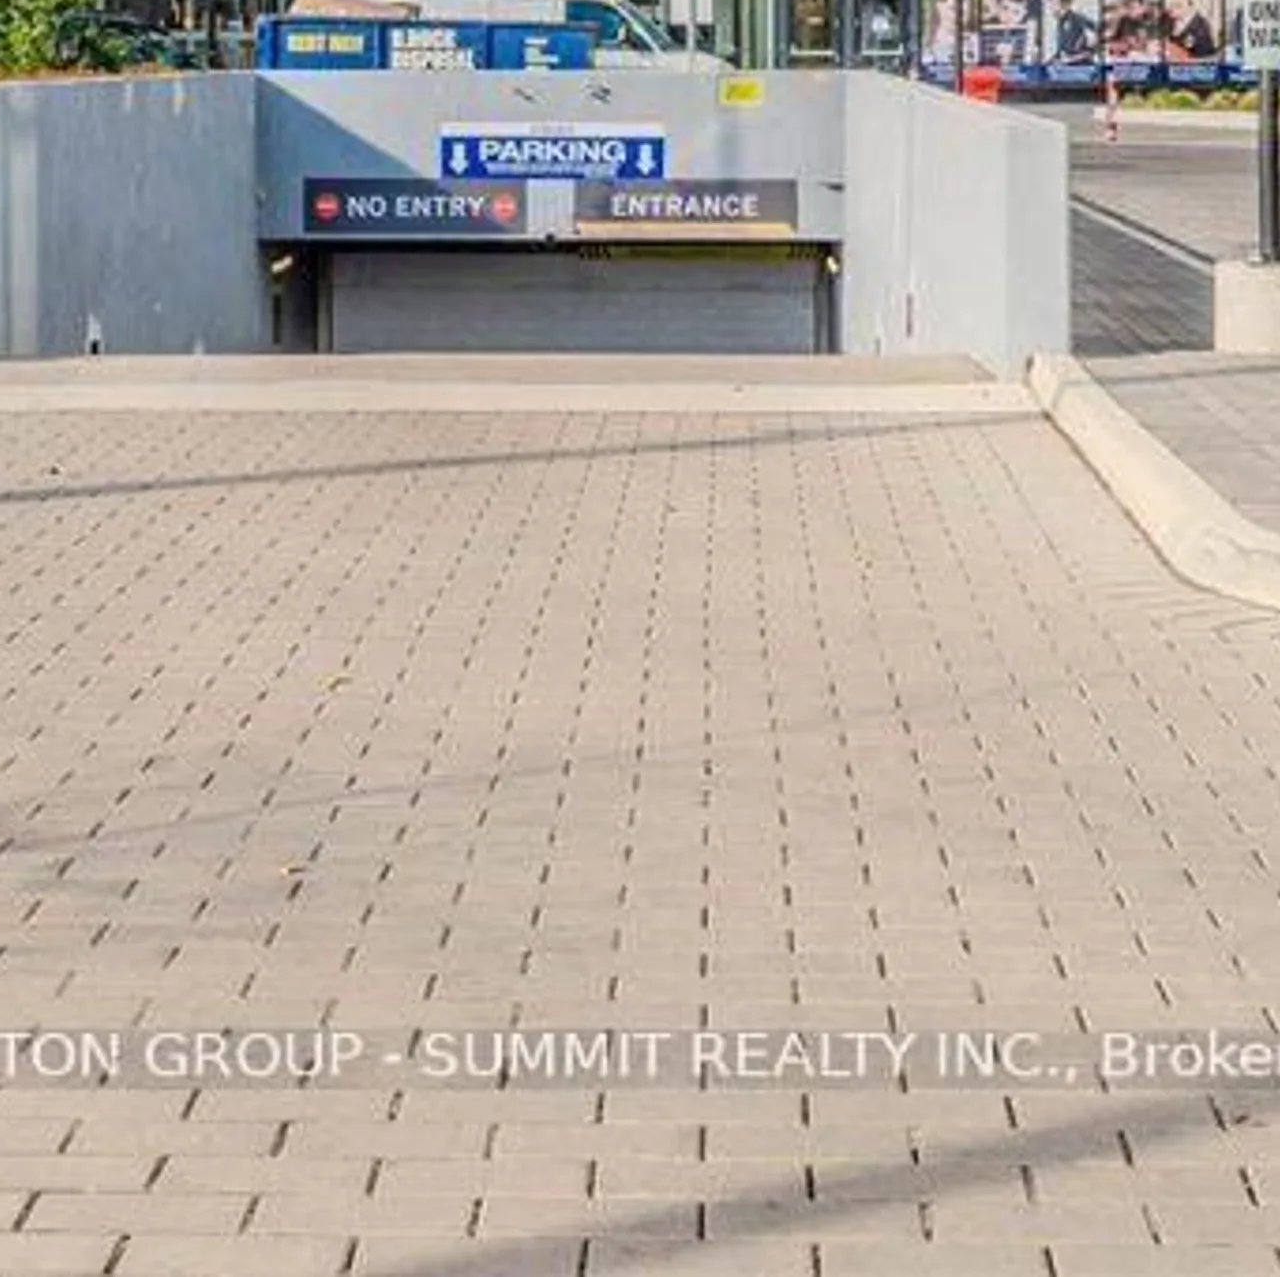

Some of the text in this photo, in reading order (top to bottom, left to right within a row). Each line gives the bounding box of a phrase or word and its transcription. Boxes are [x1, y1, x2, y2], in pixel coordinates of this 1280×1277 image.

[477, 139, 626, 164] PARKING
[346, 196, 485, 218] NO ENTRY
[611, 194, 759, 218] ENTRANCE
